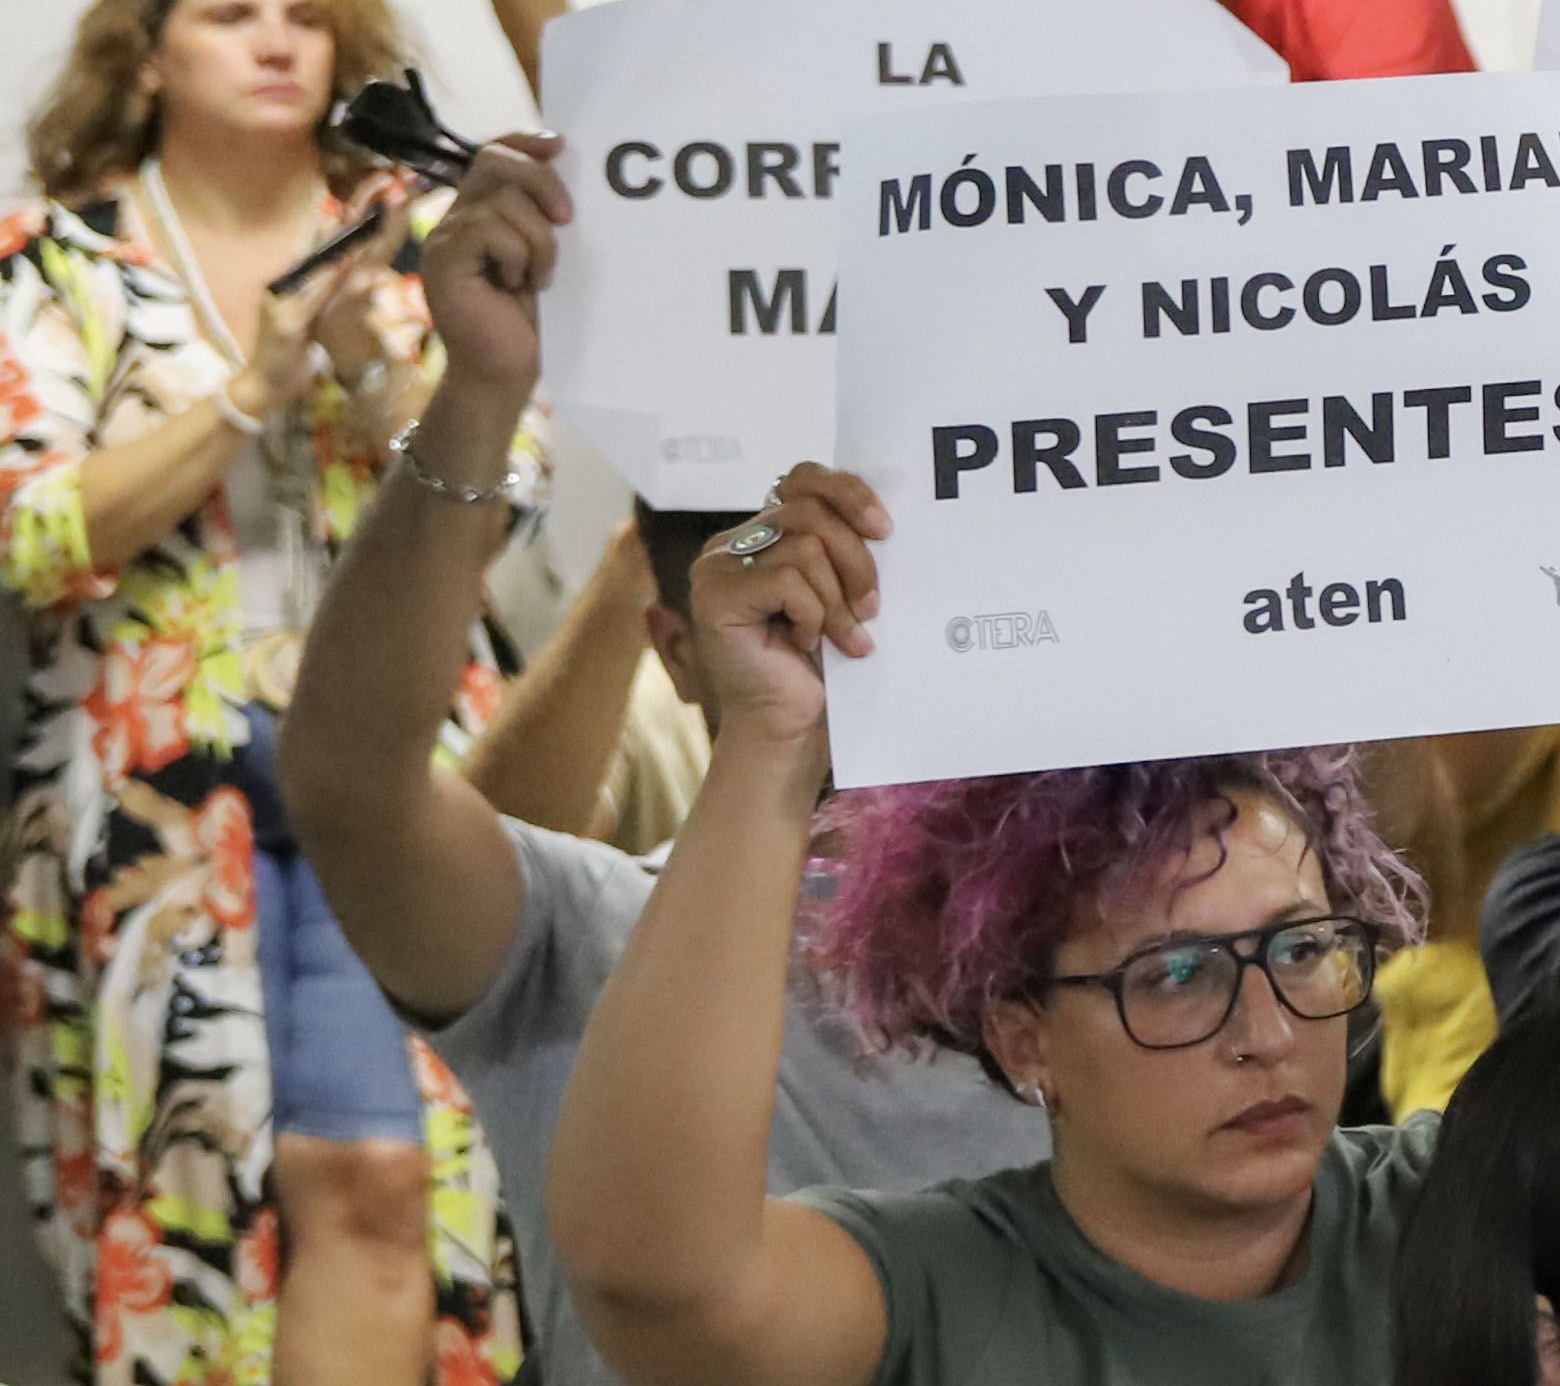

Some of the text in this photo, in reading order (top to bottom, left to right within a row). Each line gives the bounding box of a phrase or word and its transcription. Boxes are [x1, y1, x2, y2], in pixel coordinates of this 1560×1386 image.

[877, 42, 965, 86] LA
[879, 153, 1253, 237] MÓNICA,
[1043, 244, 1531, 344] Y NICOLÁS
[1243, 571, 1406, 634] aten
